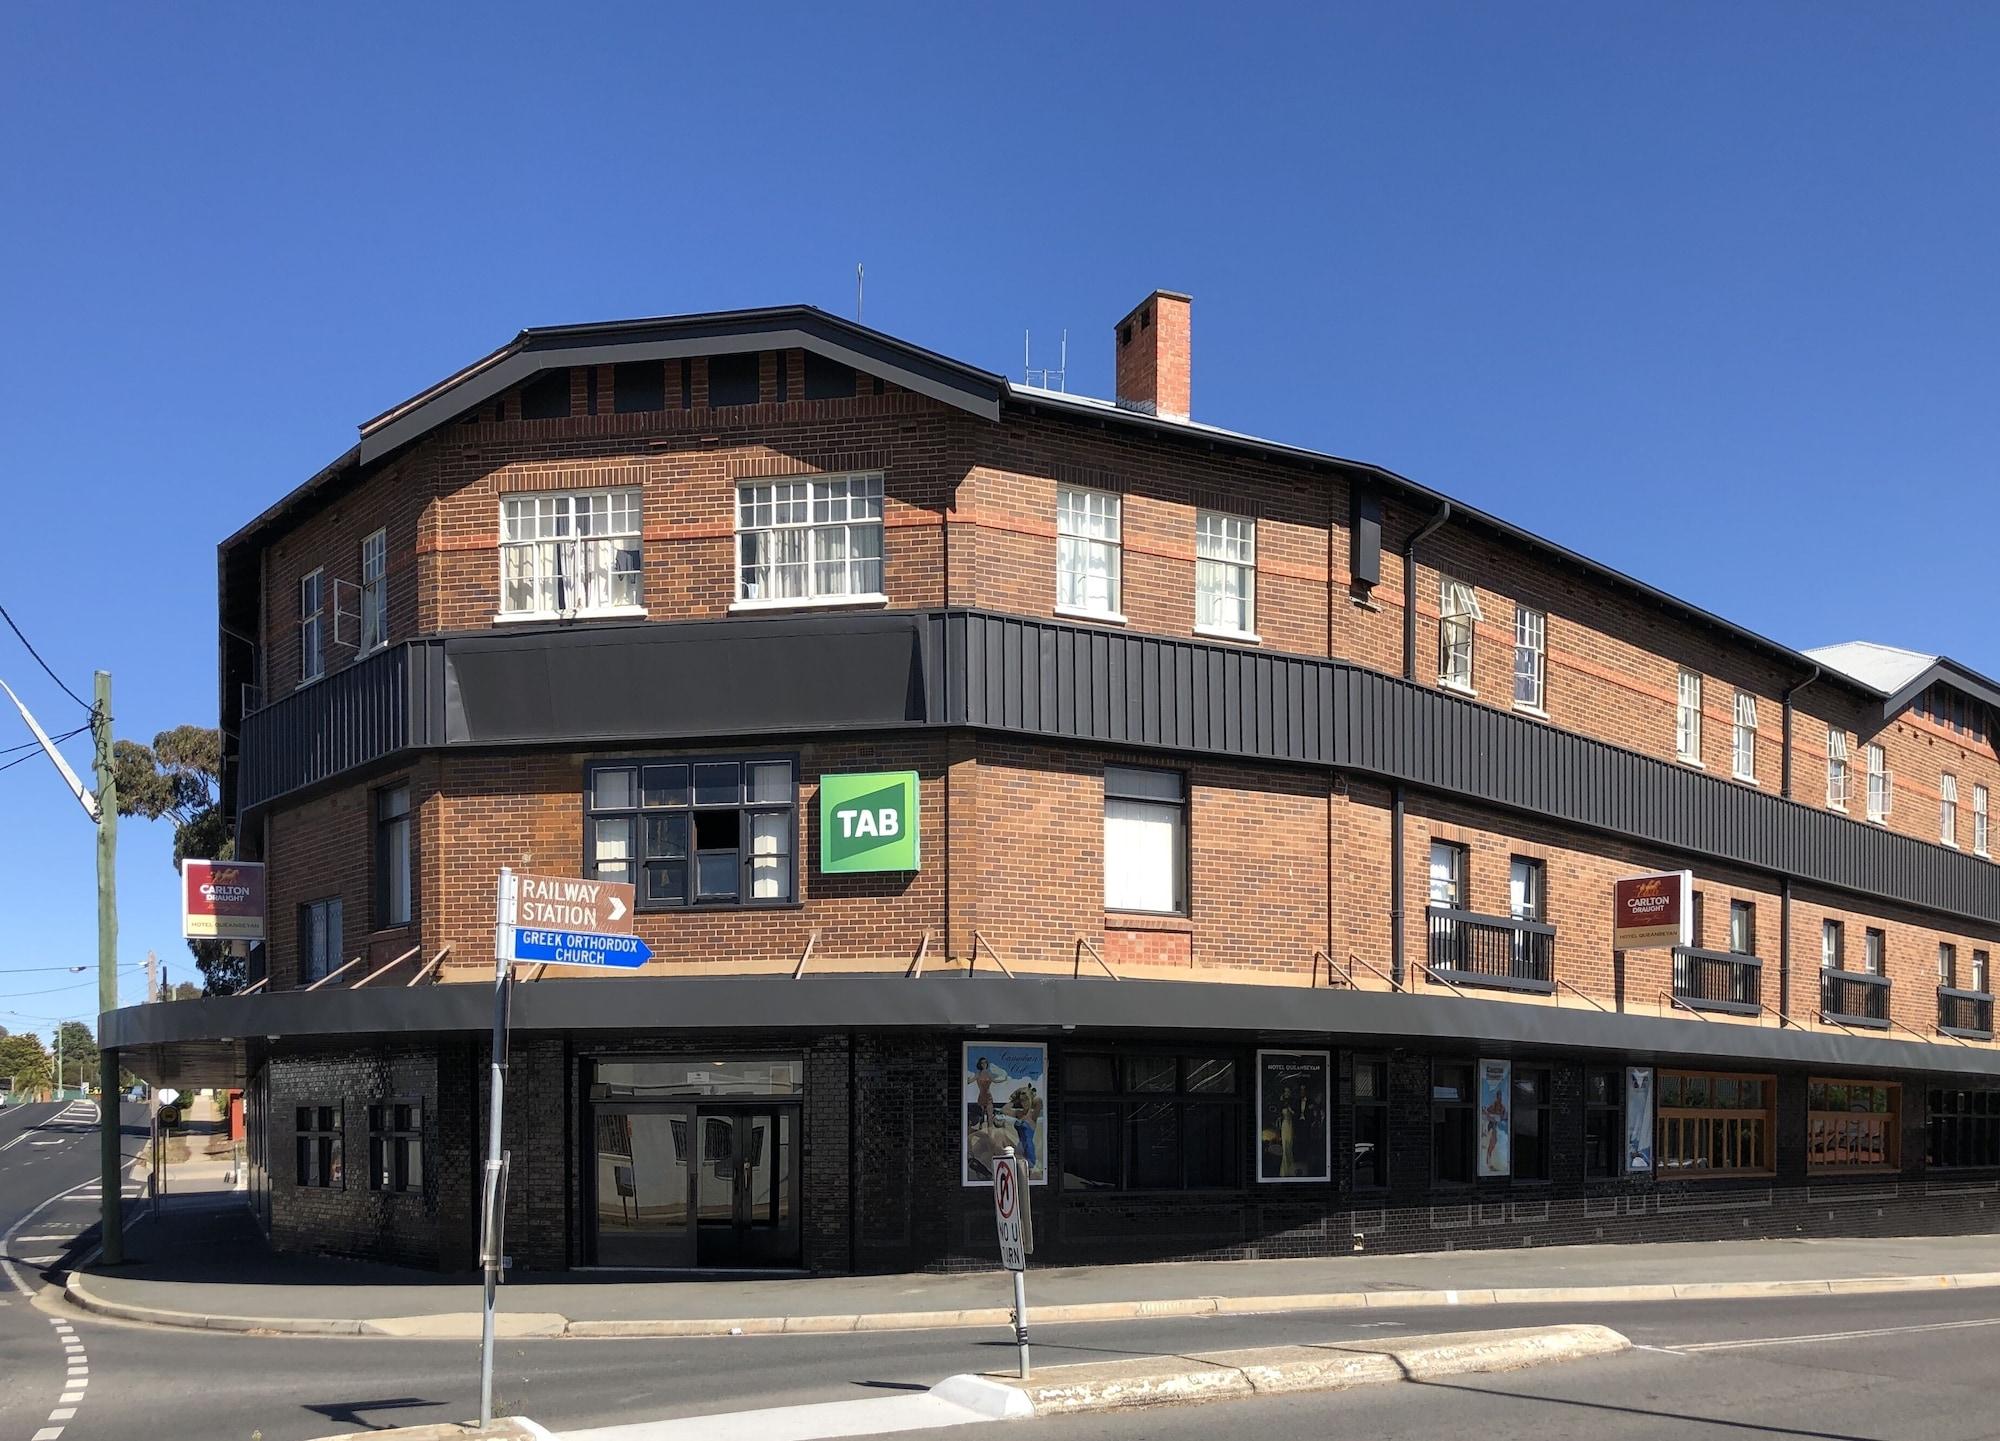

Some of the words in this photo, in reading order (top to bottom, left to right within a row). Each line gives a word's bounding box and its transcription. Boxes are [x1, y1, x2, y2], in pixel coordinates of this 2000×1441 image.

[836, 808, 899, 838] TAB
[200, 884, 250, 896] CARLTON
[206, 894, 245, 902] DRAUGHT
[522, 879, 601, 904] RAILWAY
[1627, 896, 1670, 907] CARLTON
[1632, 905, 1665, 914] DRAUGHT
[522, 902, 597, 926] STATION
[523, 931, 562, 946] GREEK
[566, 935, 638, 953] ORTHORDOX
[555, 948, 605, 964] CHURCH
[999, 1221, 1009, 1242] NO
[1011, 1222, 1018, 1242] U
